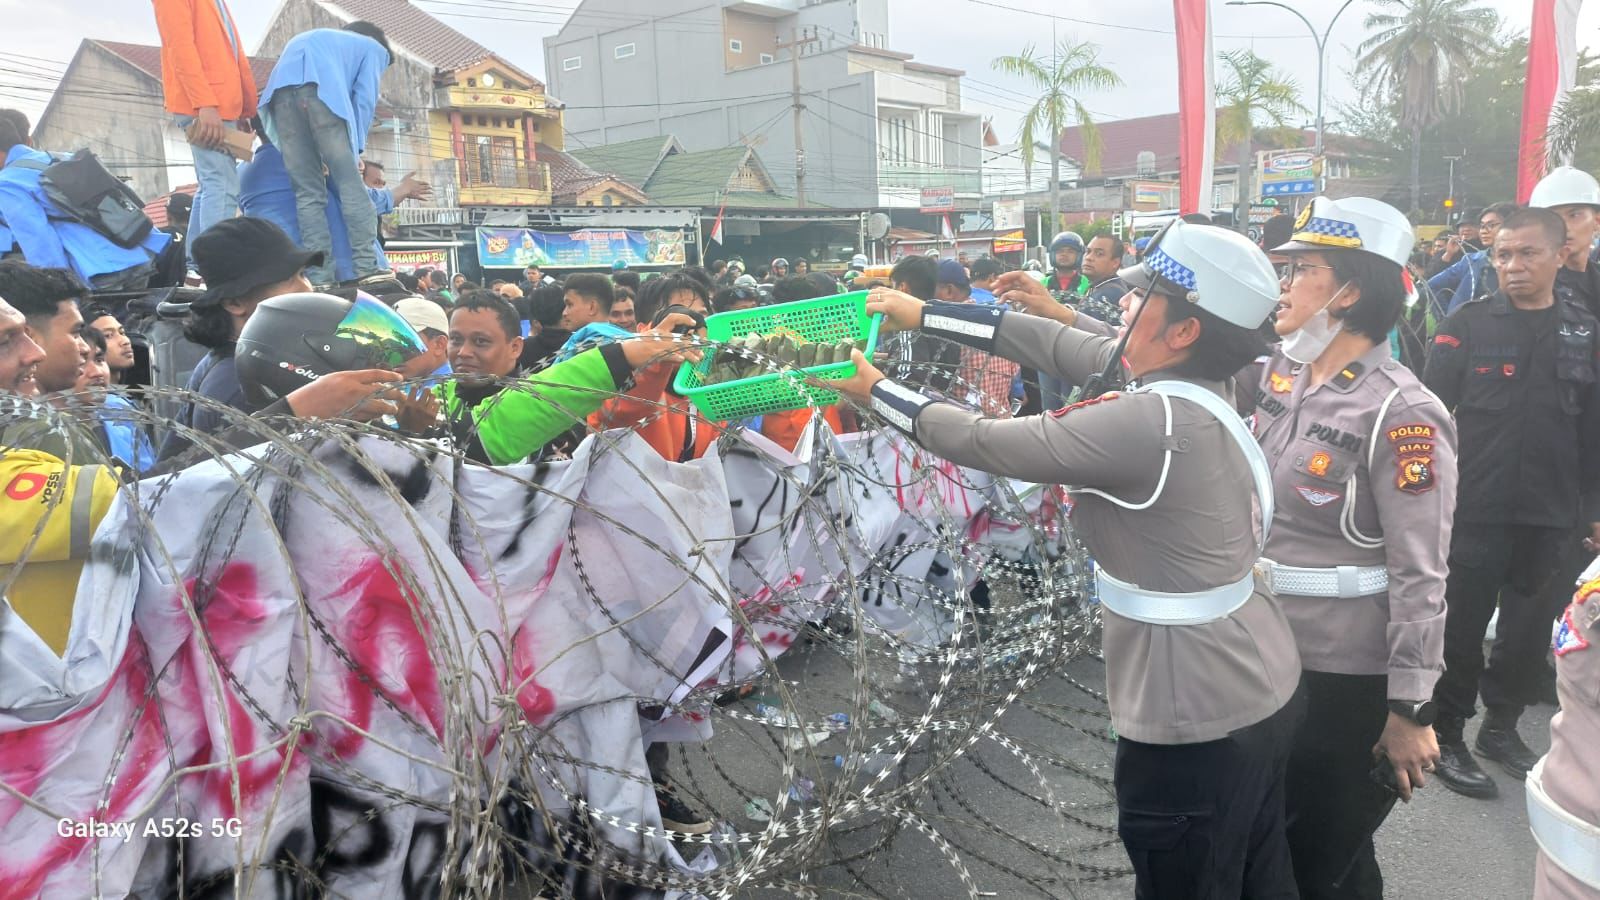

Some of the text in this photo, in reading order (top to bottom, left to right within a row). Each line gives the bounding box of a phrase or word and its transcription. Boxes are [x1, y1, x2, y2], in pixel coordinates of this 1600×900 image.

[385, 252, 430, 264] UMAHAN
[279, 361, 319, 380] evolu
[1305, 422, 1362, 453] POLRI
[1390, 426, 1431, 440] POLDA
[1399, 443, 1430, 453] RIAU
